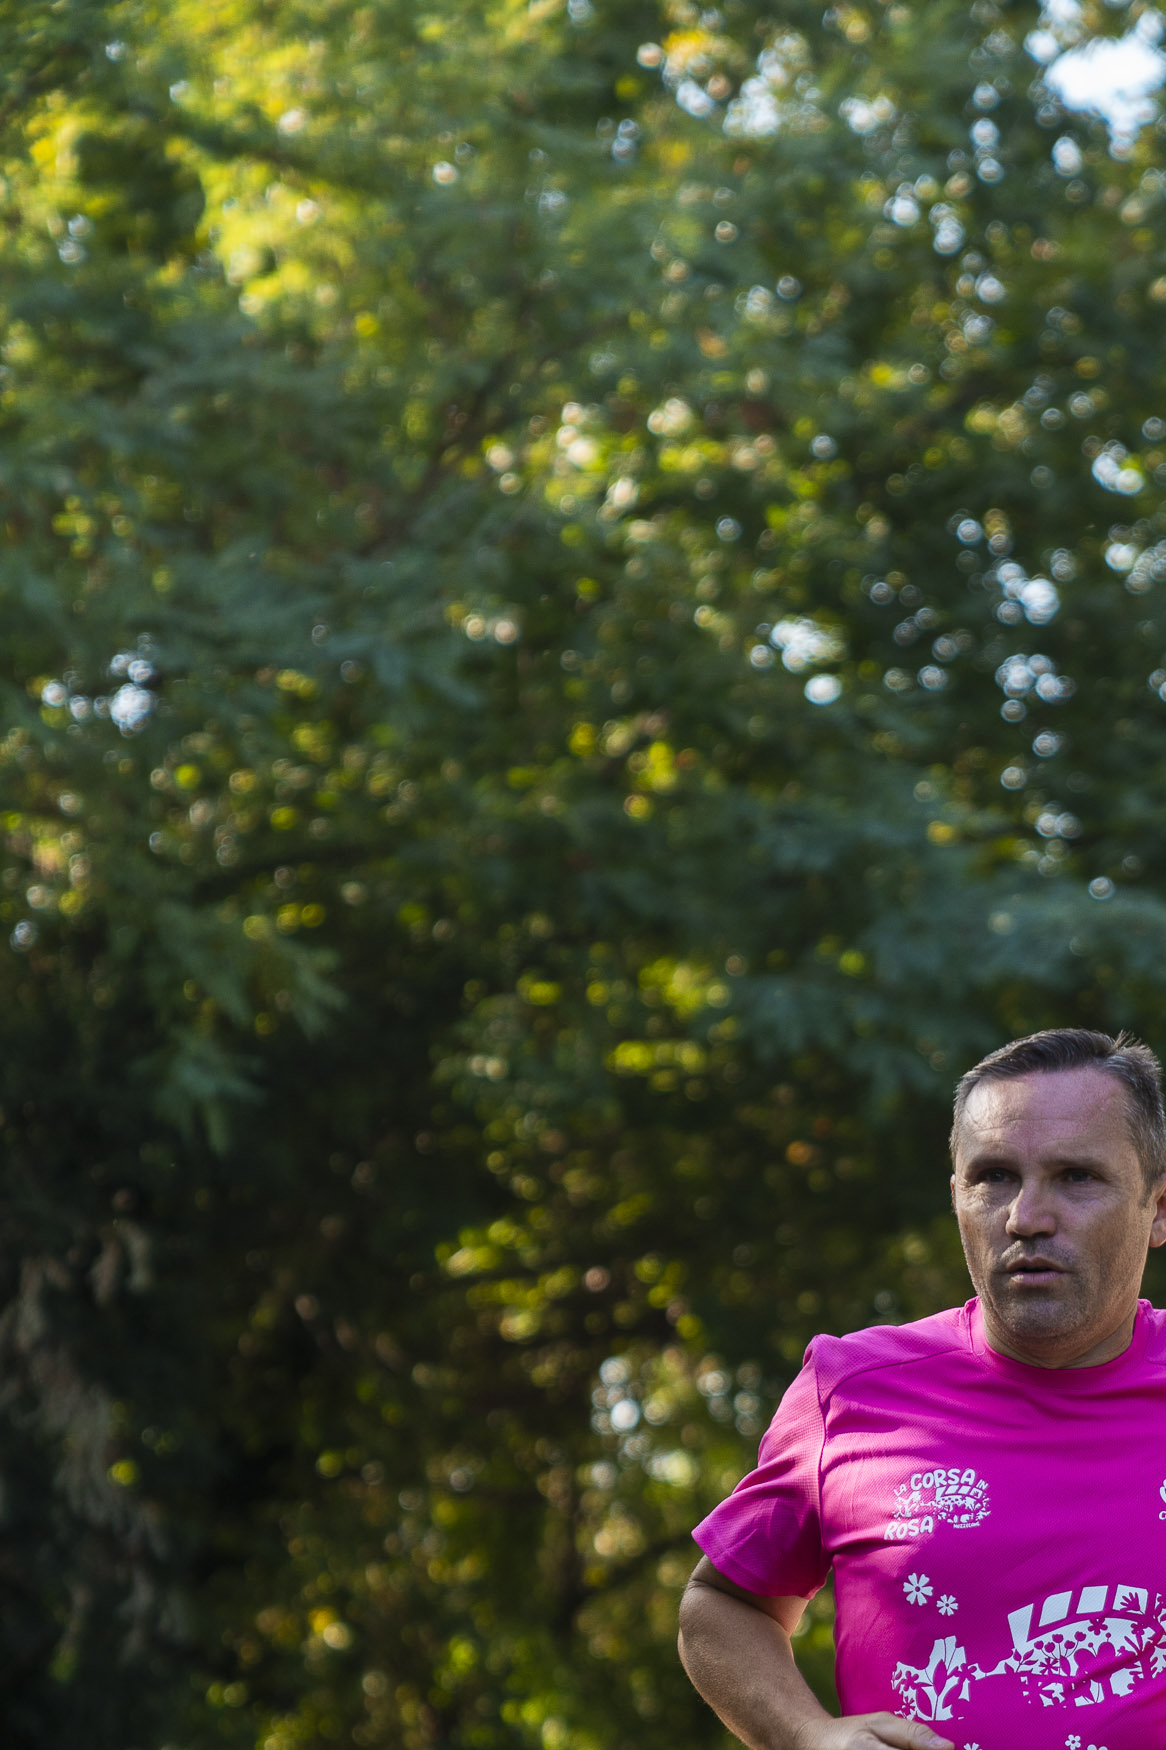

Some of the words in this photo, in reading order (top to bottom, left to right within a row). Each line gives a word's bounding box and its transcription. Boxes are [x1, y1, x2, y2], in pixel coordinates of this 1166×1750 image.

[893, 1483, 907, 1497] LA
[910, 1468, 976, 1491] CORSA
[976, 1478, 989, 1490] IN
[883, 1515, 934, 1540] ROSA
